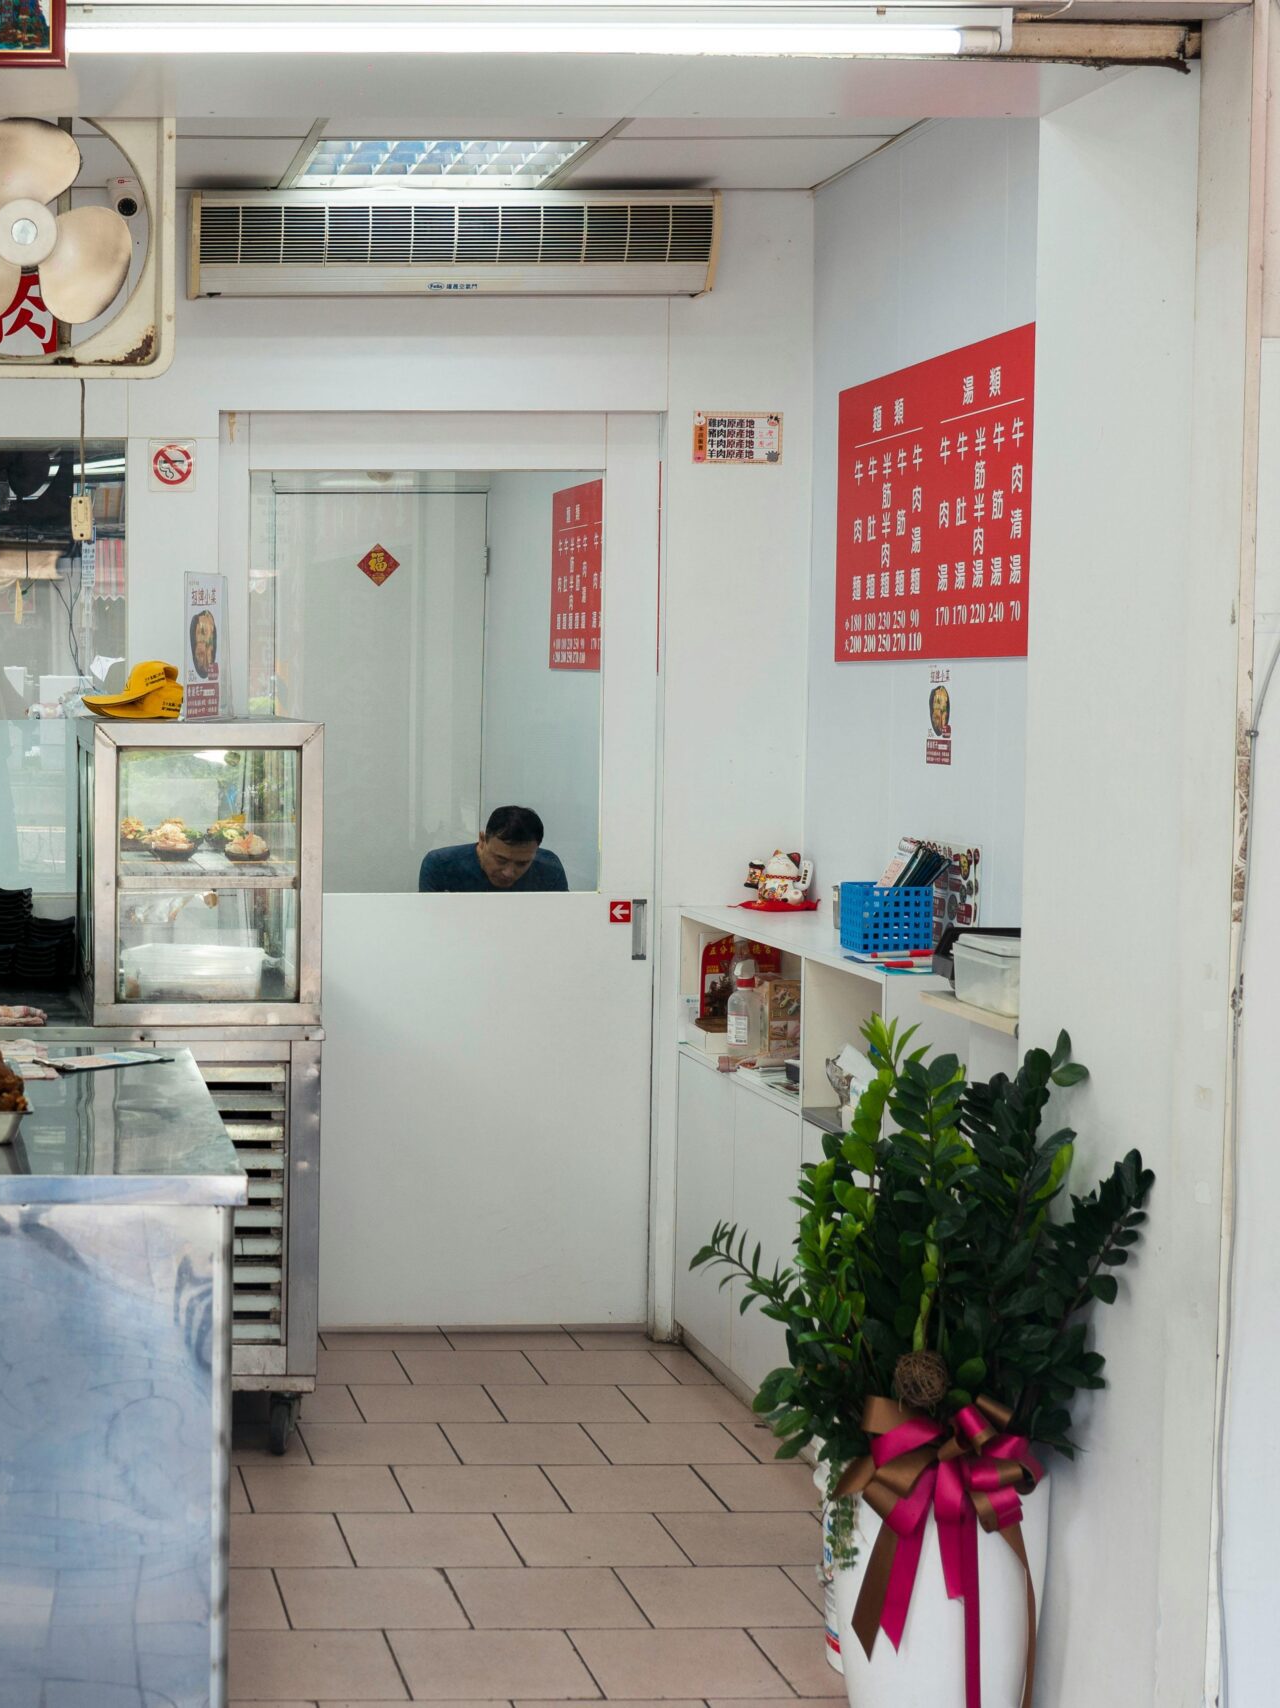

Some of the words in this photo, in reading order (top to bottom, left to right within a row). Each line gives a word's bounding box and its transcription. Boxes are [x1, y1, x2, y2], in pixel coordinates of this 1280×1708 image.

[707, 439, 755, 449] 牛肉原產地
[707, 449, 754, 459] 羊肉原產地
[708, 429, 755, 439] 豬肉原產地
[872, 397, 905, 433] 麵類
[962, 366, 1002, 406] 湯類
[368, 552, 388, 572] 福
[851, 459, 864, 601] 牛肉麵
[865, 455, 878, 600] 牛肚麵
[879, 452, 892, 599] 半筋半肉麵
[894, 447, 907, 598] 牛筋麵
[909, 443, 923, 596] 牛肉湯麵
[936, 436, 951, 593] 牛肉湯
[954, 431, 969, 591] 牛肚湯
[971, 426, 987, 589] 半筋半肉湯
[989, 422, 1005, 587] 牛筋湯
[1008, 417, 1024, 585] 牛肉清湯
[849, 635, 862, 653] 200
[863, 635, 876, 653] 200
[877, 634, 891, 652] 250
[892, 633, 906, 652] 270
[908, 632, 922, 651] 110
[850, 613, 862, 632] 180
[863, 612, 876, 631] 180
[877, 611, 891, 630] 230
[892, 610, 906, 629] 250
[910, 609, 920, 628] 90
[935, 606, 950, 626] 170
[952, 605, 967, 625] 170
[969, 603, 985, 624] 220
[987, 602, 1004, 623] 240
[1010, 600, 1021, 622] 70
